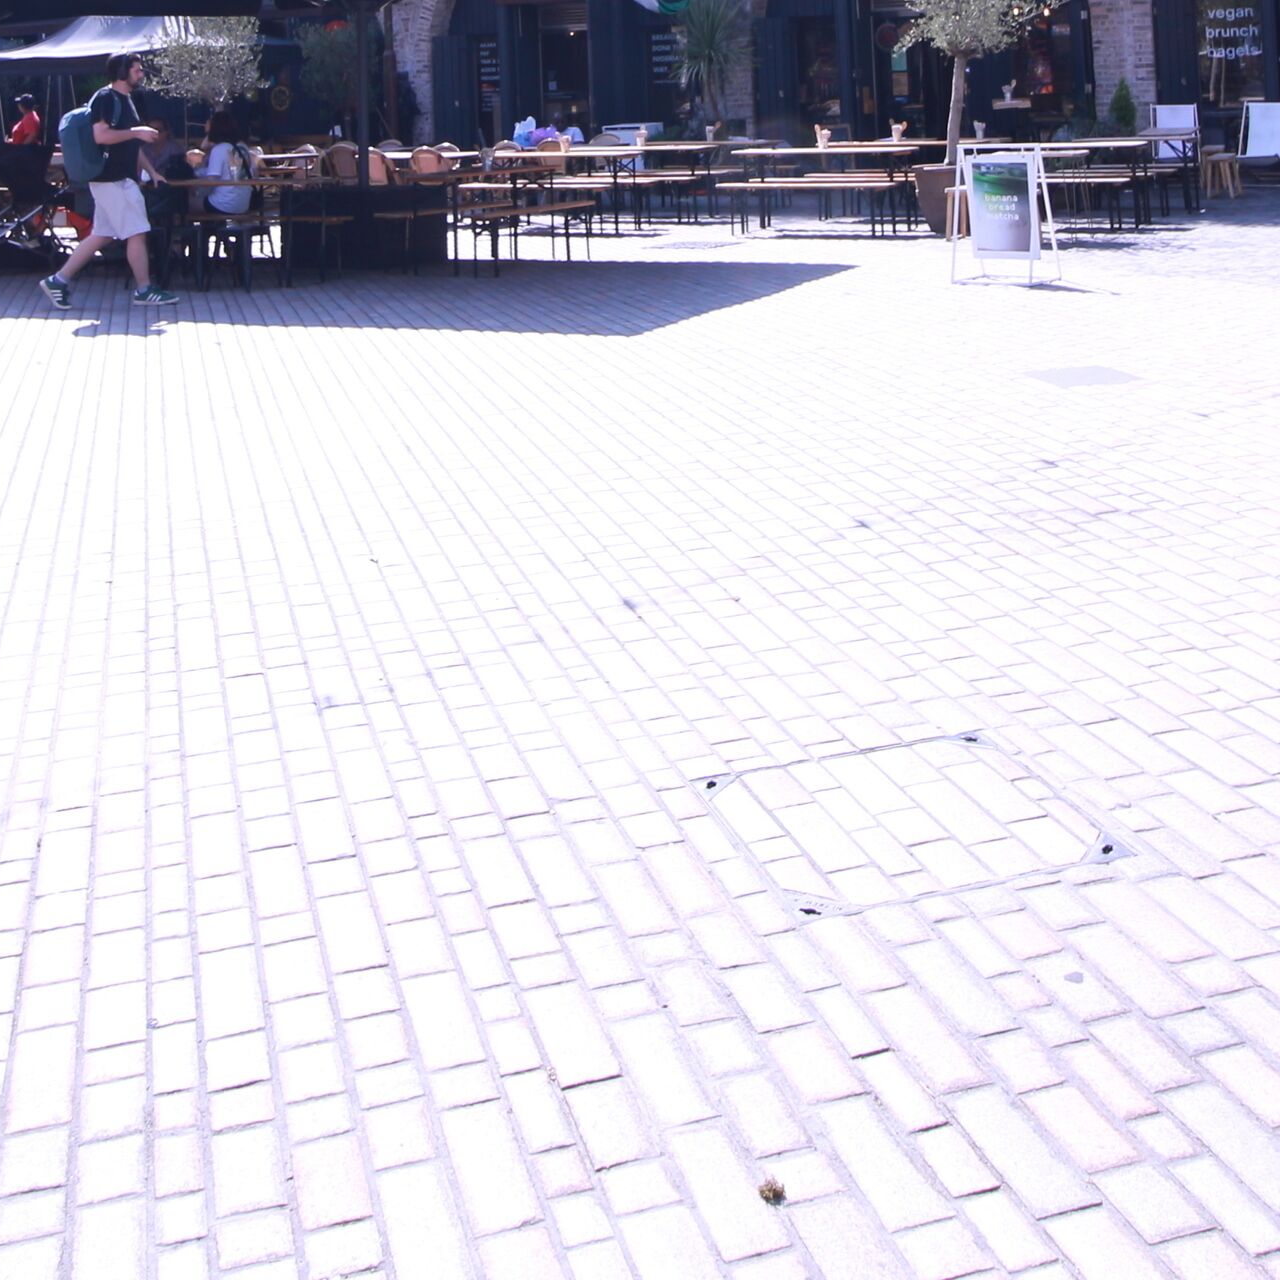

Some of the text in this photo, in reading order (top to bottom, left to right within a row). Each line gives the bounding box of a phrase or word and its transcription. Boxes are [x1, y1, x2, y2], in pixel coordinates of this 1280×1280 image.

[1207, 7, 1254, 22] vegan
[1205, 24, 1259, 39] brunch
[1206, 45, 1260, 60] bagels
[984, 193, 1018, 202] banana
